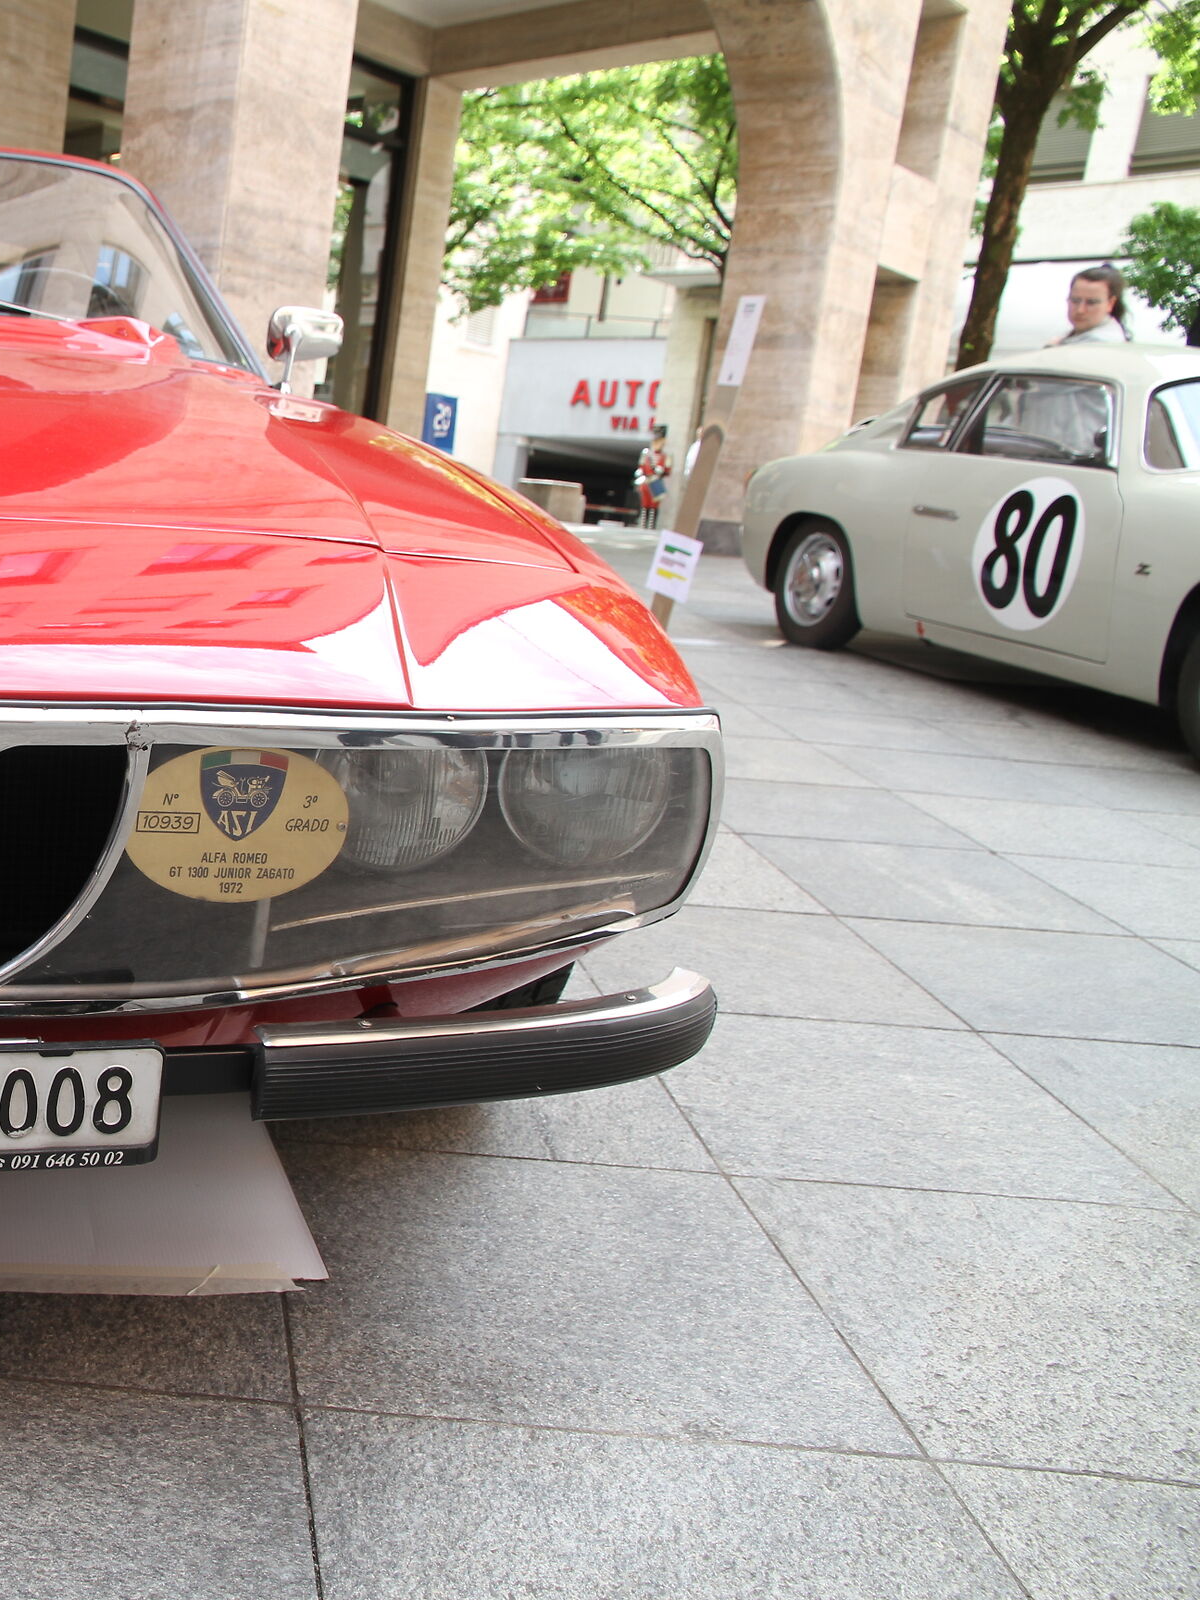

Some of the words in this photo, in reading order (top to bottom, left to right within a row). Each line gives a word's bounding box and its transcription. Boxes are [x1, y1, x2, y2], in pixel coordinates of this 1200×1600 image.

[611, 416, 640, 431] VIA
[980, 490, 1078, 618] 80
[142, 814, 194, 831] 10939
[284, 818, 330, 832] GRADO
[200, 852, 227, 864] ALFA
[232, 852, 268, 865] ROMEO
[168, 866, 183, 878] GT
[187, 866, 209, 878] 1300
[213, 866, 252, 879] JUNIOR
[256, 867, 295, 880] ZAGATO
[219, 882, 244, 894] 1972
[10, 1154, 41, 1170] 091
[45, 1152, 76, 1168] 646
[79, 1151, 100, 1167] 50
[104, 1150, 125, 1166] 02
